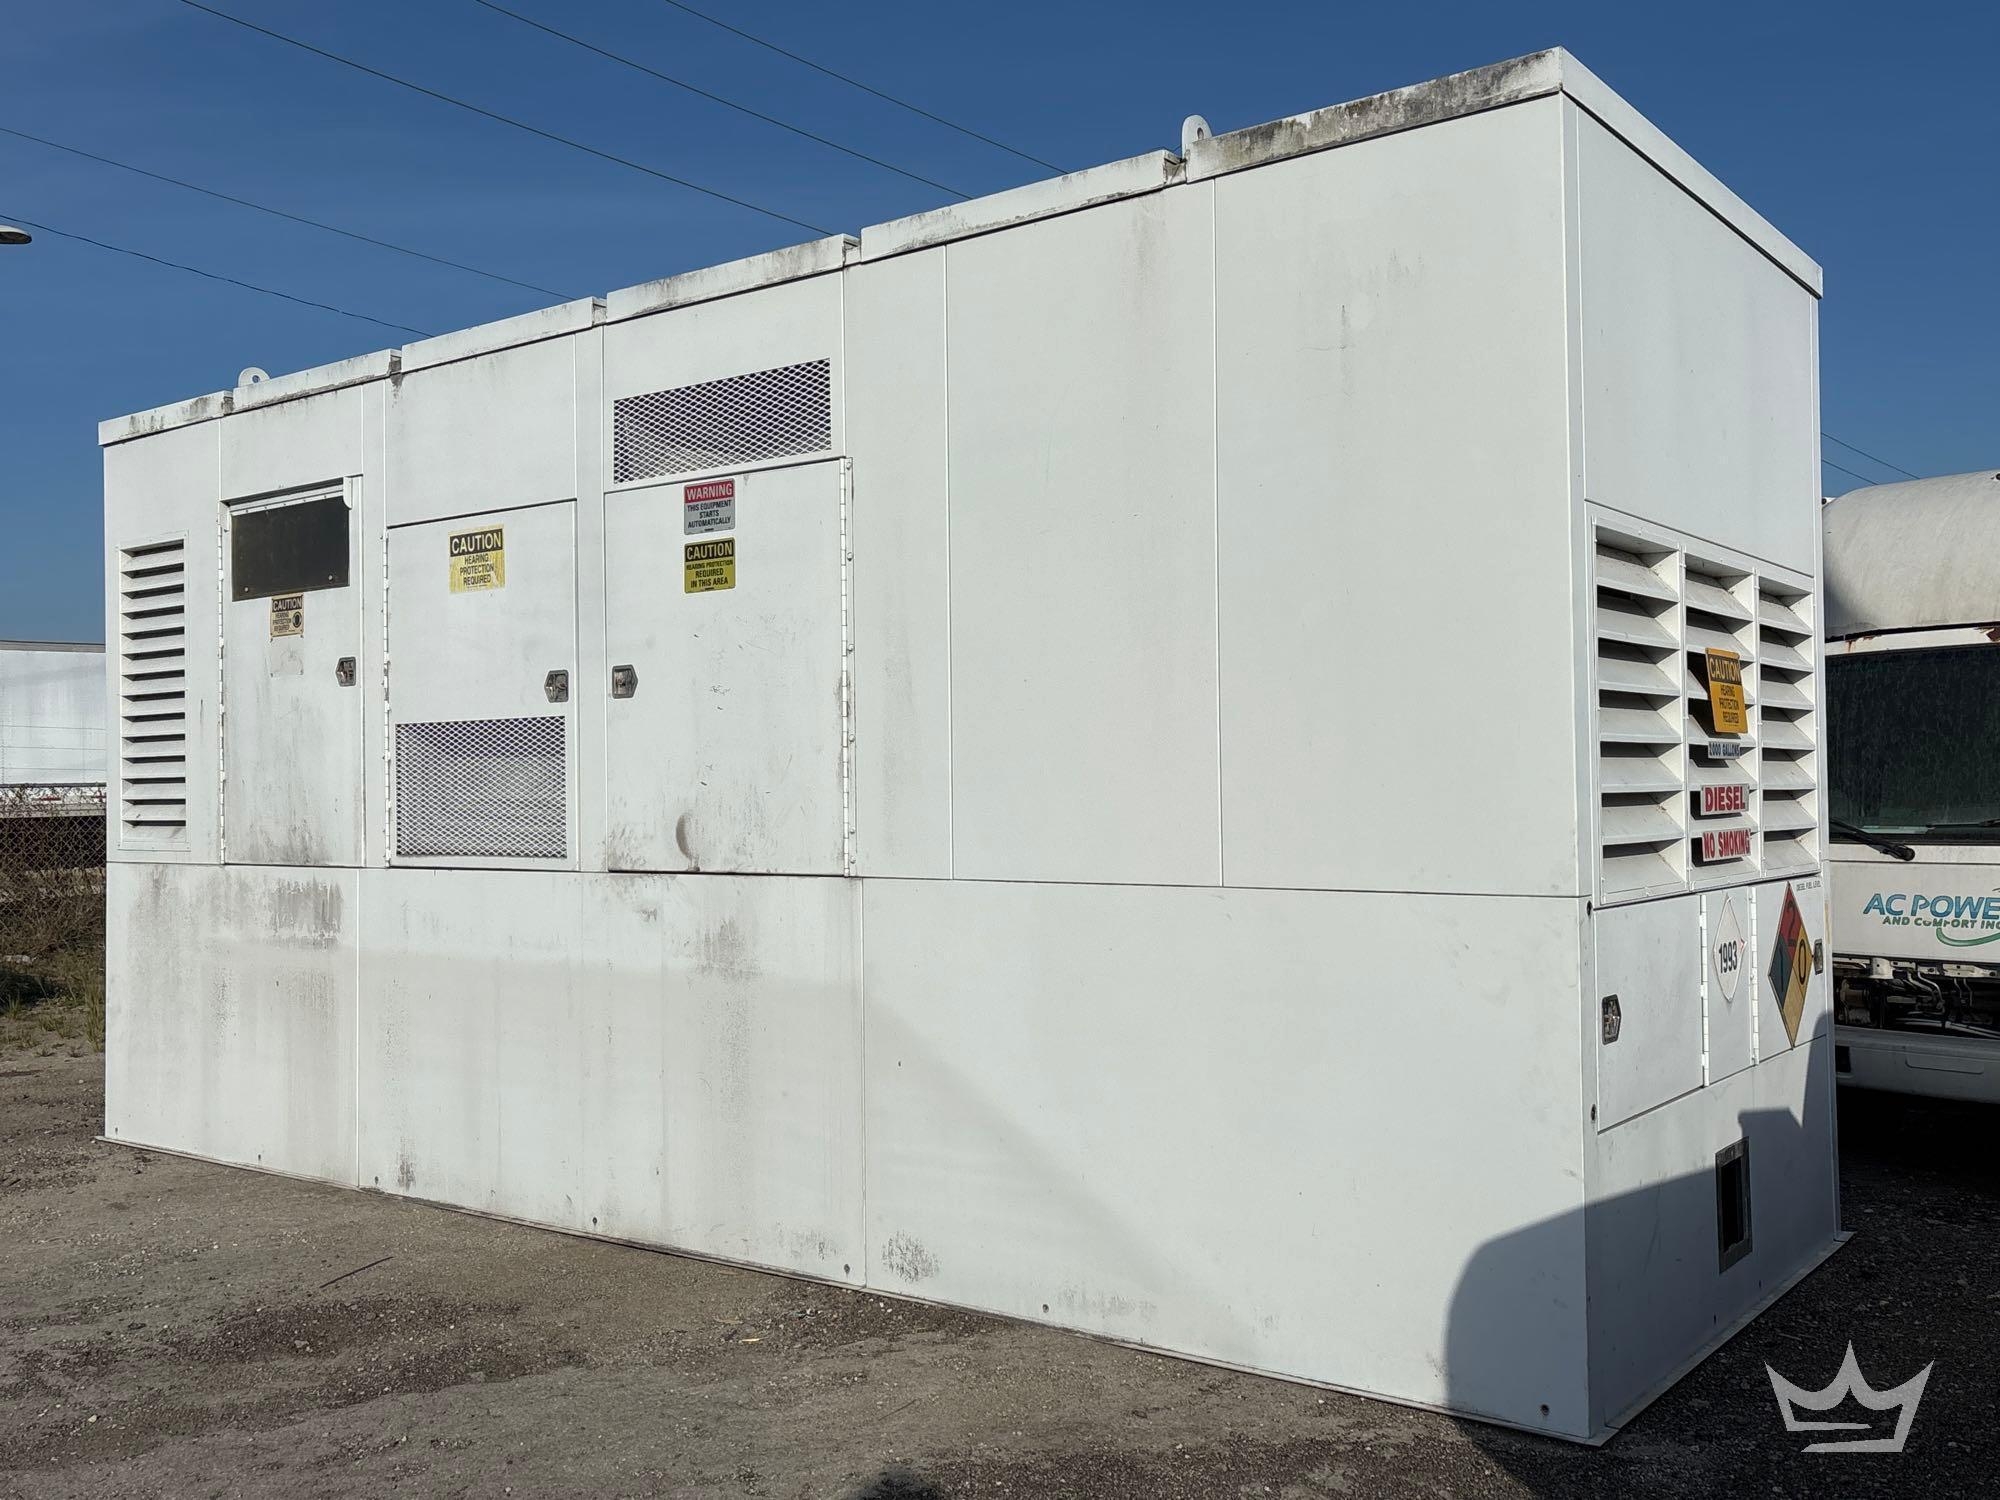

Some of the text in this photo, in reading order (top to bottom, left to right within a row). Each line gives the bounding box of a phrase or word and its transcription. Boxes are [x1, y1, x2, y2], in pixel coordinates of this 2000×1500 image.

[686, 483, 733, 501] WARNING
[687, 500, 731, 512] THIS EQUIPMENT
[699, 510, 719, 519] STARTS
[688, 517, 731, 528] AUTOMATICALLY
[451, 531, 501, 554] CAUTION
[686, 542, 732, 560] CAUTION
[464, 553, 489, 565] HEARING
[686, 559, 733, 570] HEARING PROTECTION
[460, 563, 494, 576] PROTECTION
[695, 568, 724, 578] REQUIRED
[463, 574, 491, 585] REQUIRED
[690, 576, 728, 588] IN THIS AREA
[273, 597, 302, 611] CAUTION
[1709, 658, 1741, 681] CAUTION
[1705, 786, 1745, 812] DIESEL
[1703, 829, 1750, 858] NO SMOKING
[1863, 893, 2000, 920] AC POWE
[1788, 901, 1797, 946] 2
[1882, 916, 1910, 926] AND
[1719, 941, 1738, 973] 1993
[1798, 938, 1807, 985] 0
